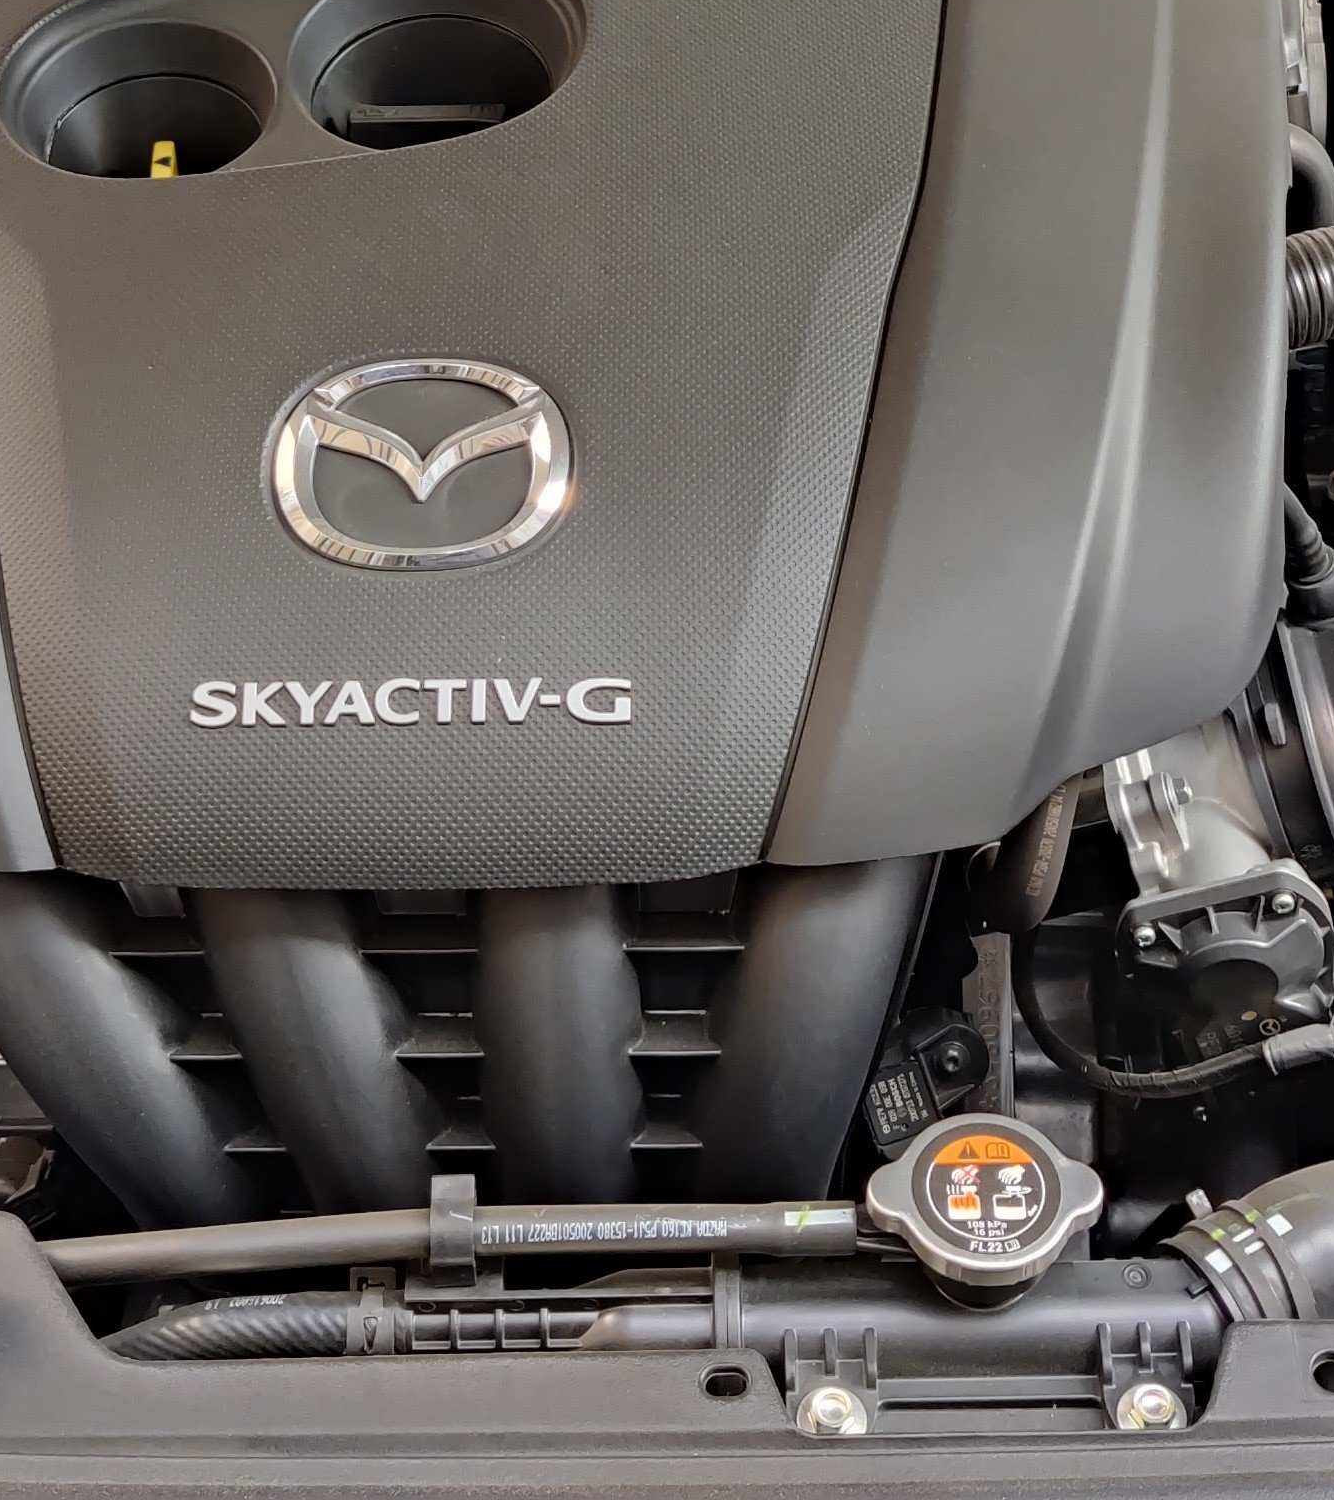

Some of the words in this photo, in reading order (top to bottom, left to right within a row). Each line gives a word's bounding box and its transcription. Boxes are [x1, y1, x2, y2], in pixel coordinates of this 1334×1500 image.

[189, 676, 632, 727] SKYACTIV-G
[888, 1078, 904, 1108] BOSCH
[697, 1219, 728, 1238] MAZDA
[967, 1220, 985, 1228] 108
[988, 1220, 1007, 1228] kPa
[988, 1229, 1005, 1237] psi
[969, 1240, 1003, 1253] FL22
